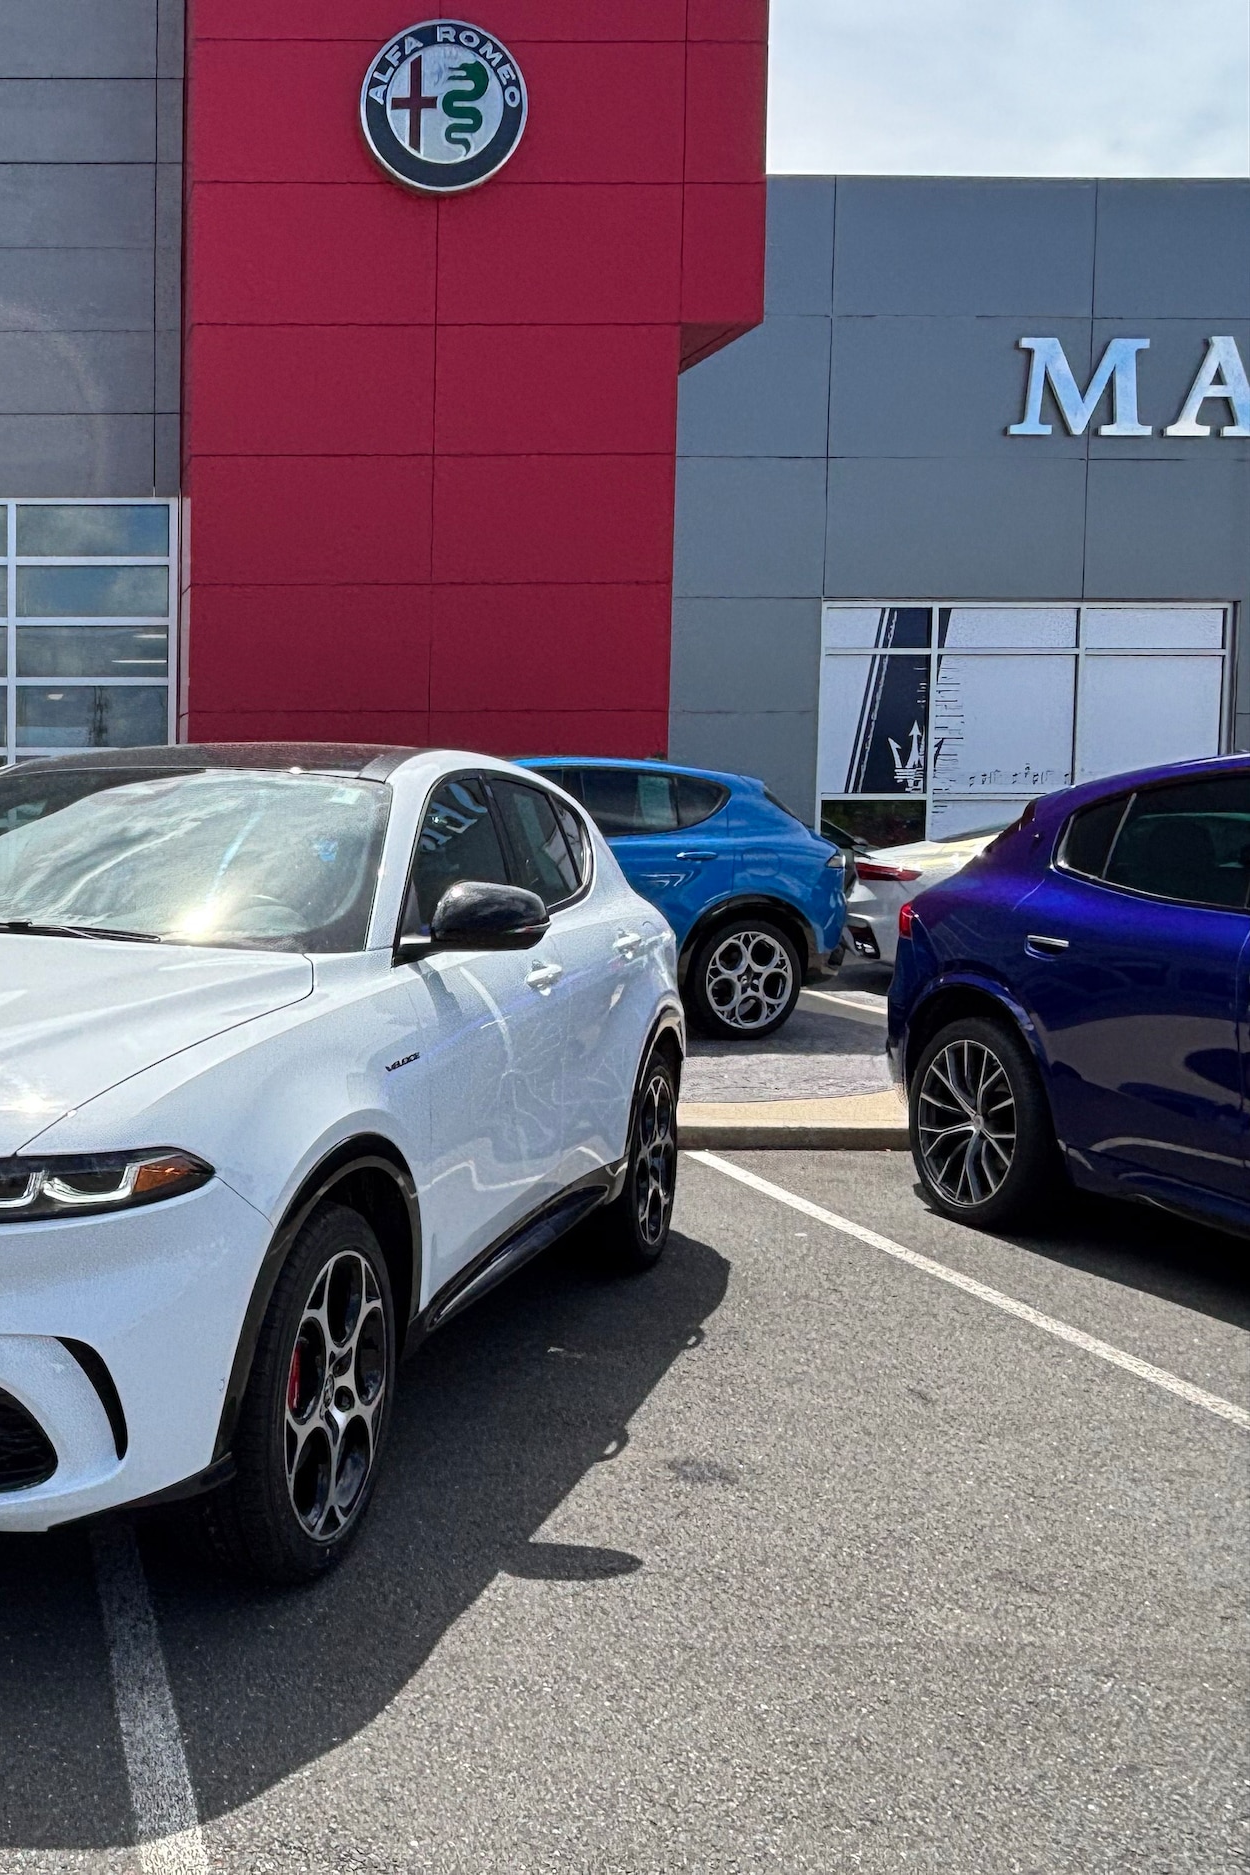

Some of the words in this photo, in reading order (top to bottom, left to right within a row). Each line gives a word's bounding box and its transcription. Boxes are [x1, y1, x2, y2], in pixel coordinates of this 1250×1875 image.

[368, 35, 424, 106] ALFA
[436, 25, 521, 108] ROMEO
[1006, 335, 1250, 437] MA
